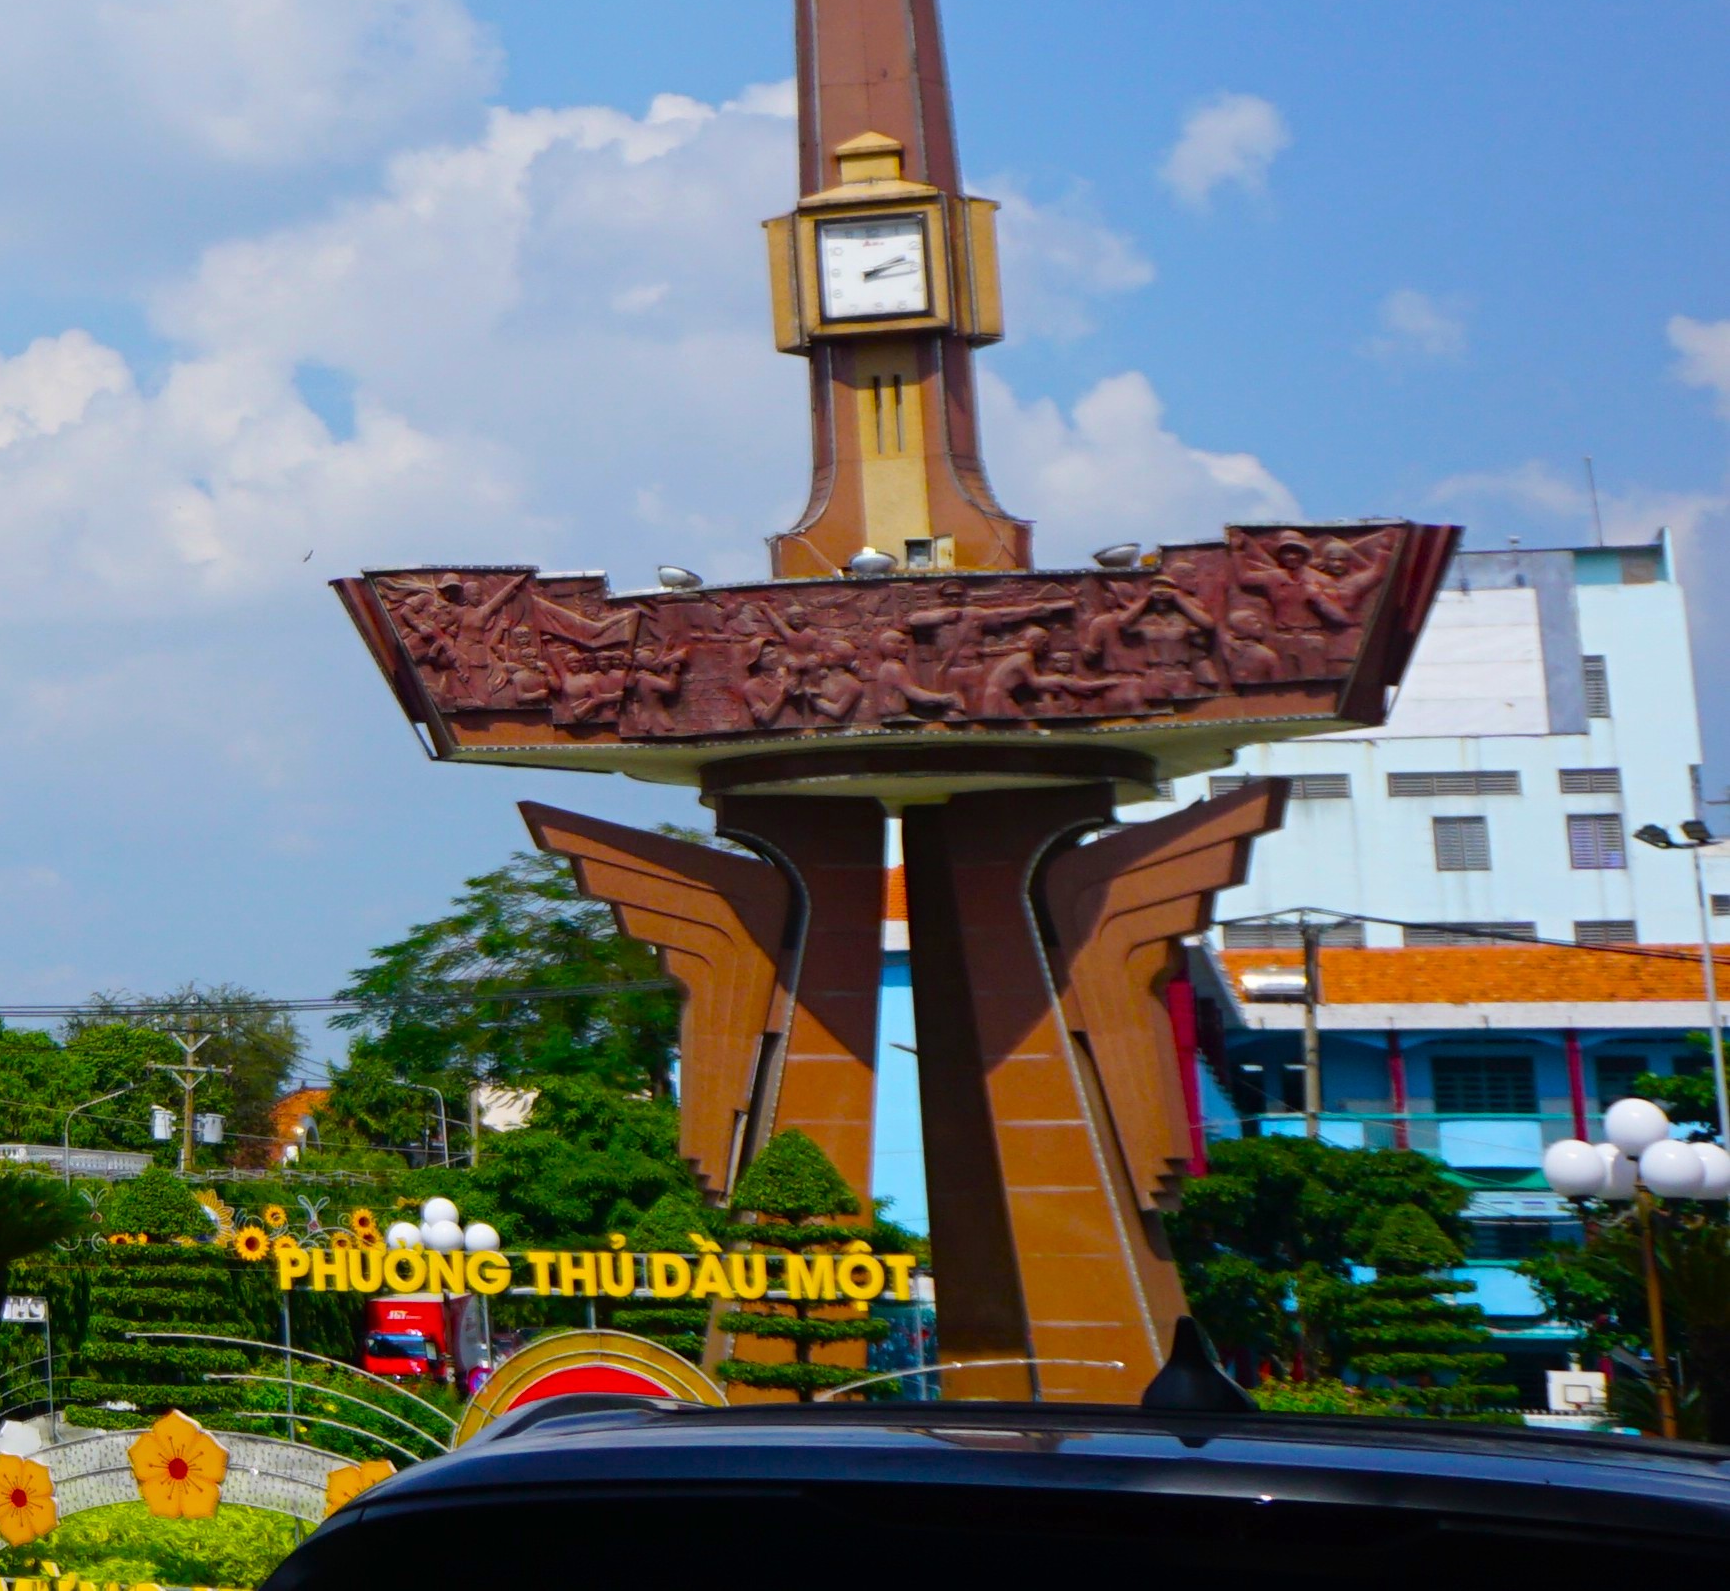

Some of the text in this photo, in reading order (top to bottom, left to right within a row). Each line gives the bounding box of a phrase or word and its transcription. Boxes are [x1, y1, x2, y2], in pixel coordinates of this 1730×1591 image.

[909, 240, 920, 250] 2
[278, 1233, 915, 1311] PHƯỜNG THỦ DẦU MỘT
